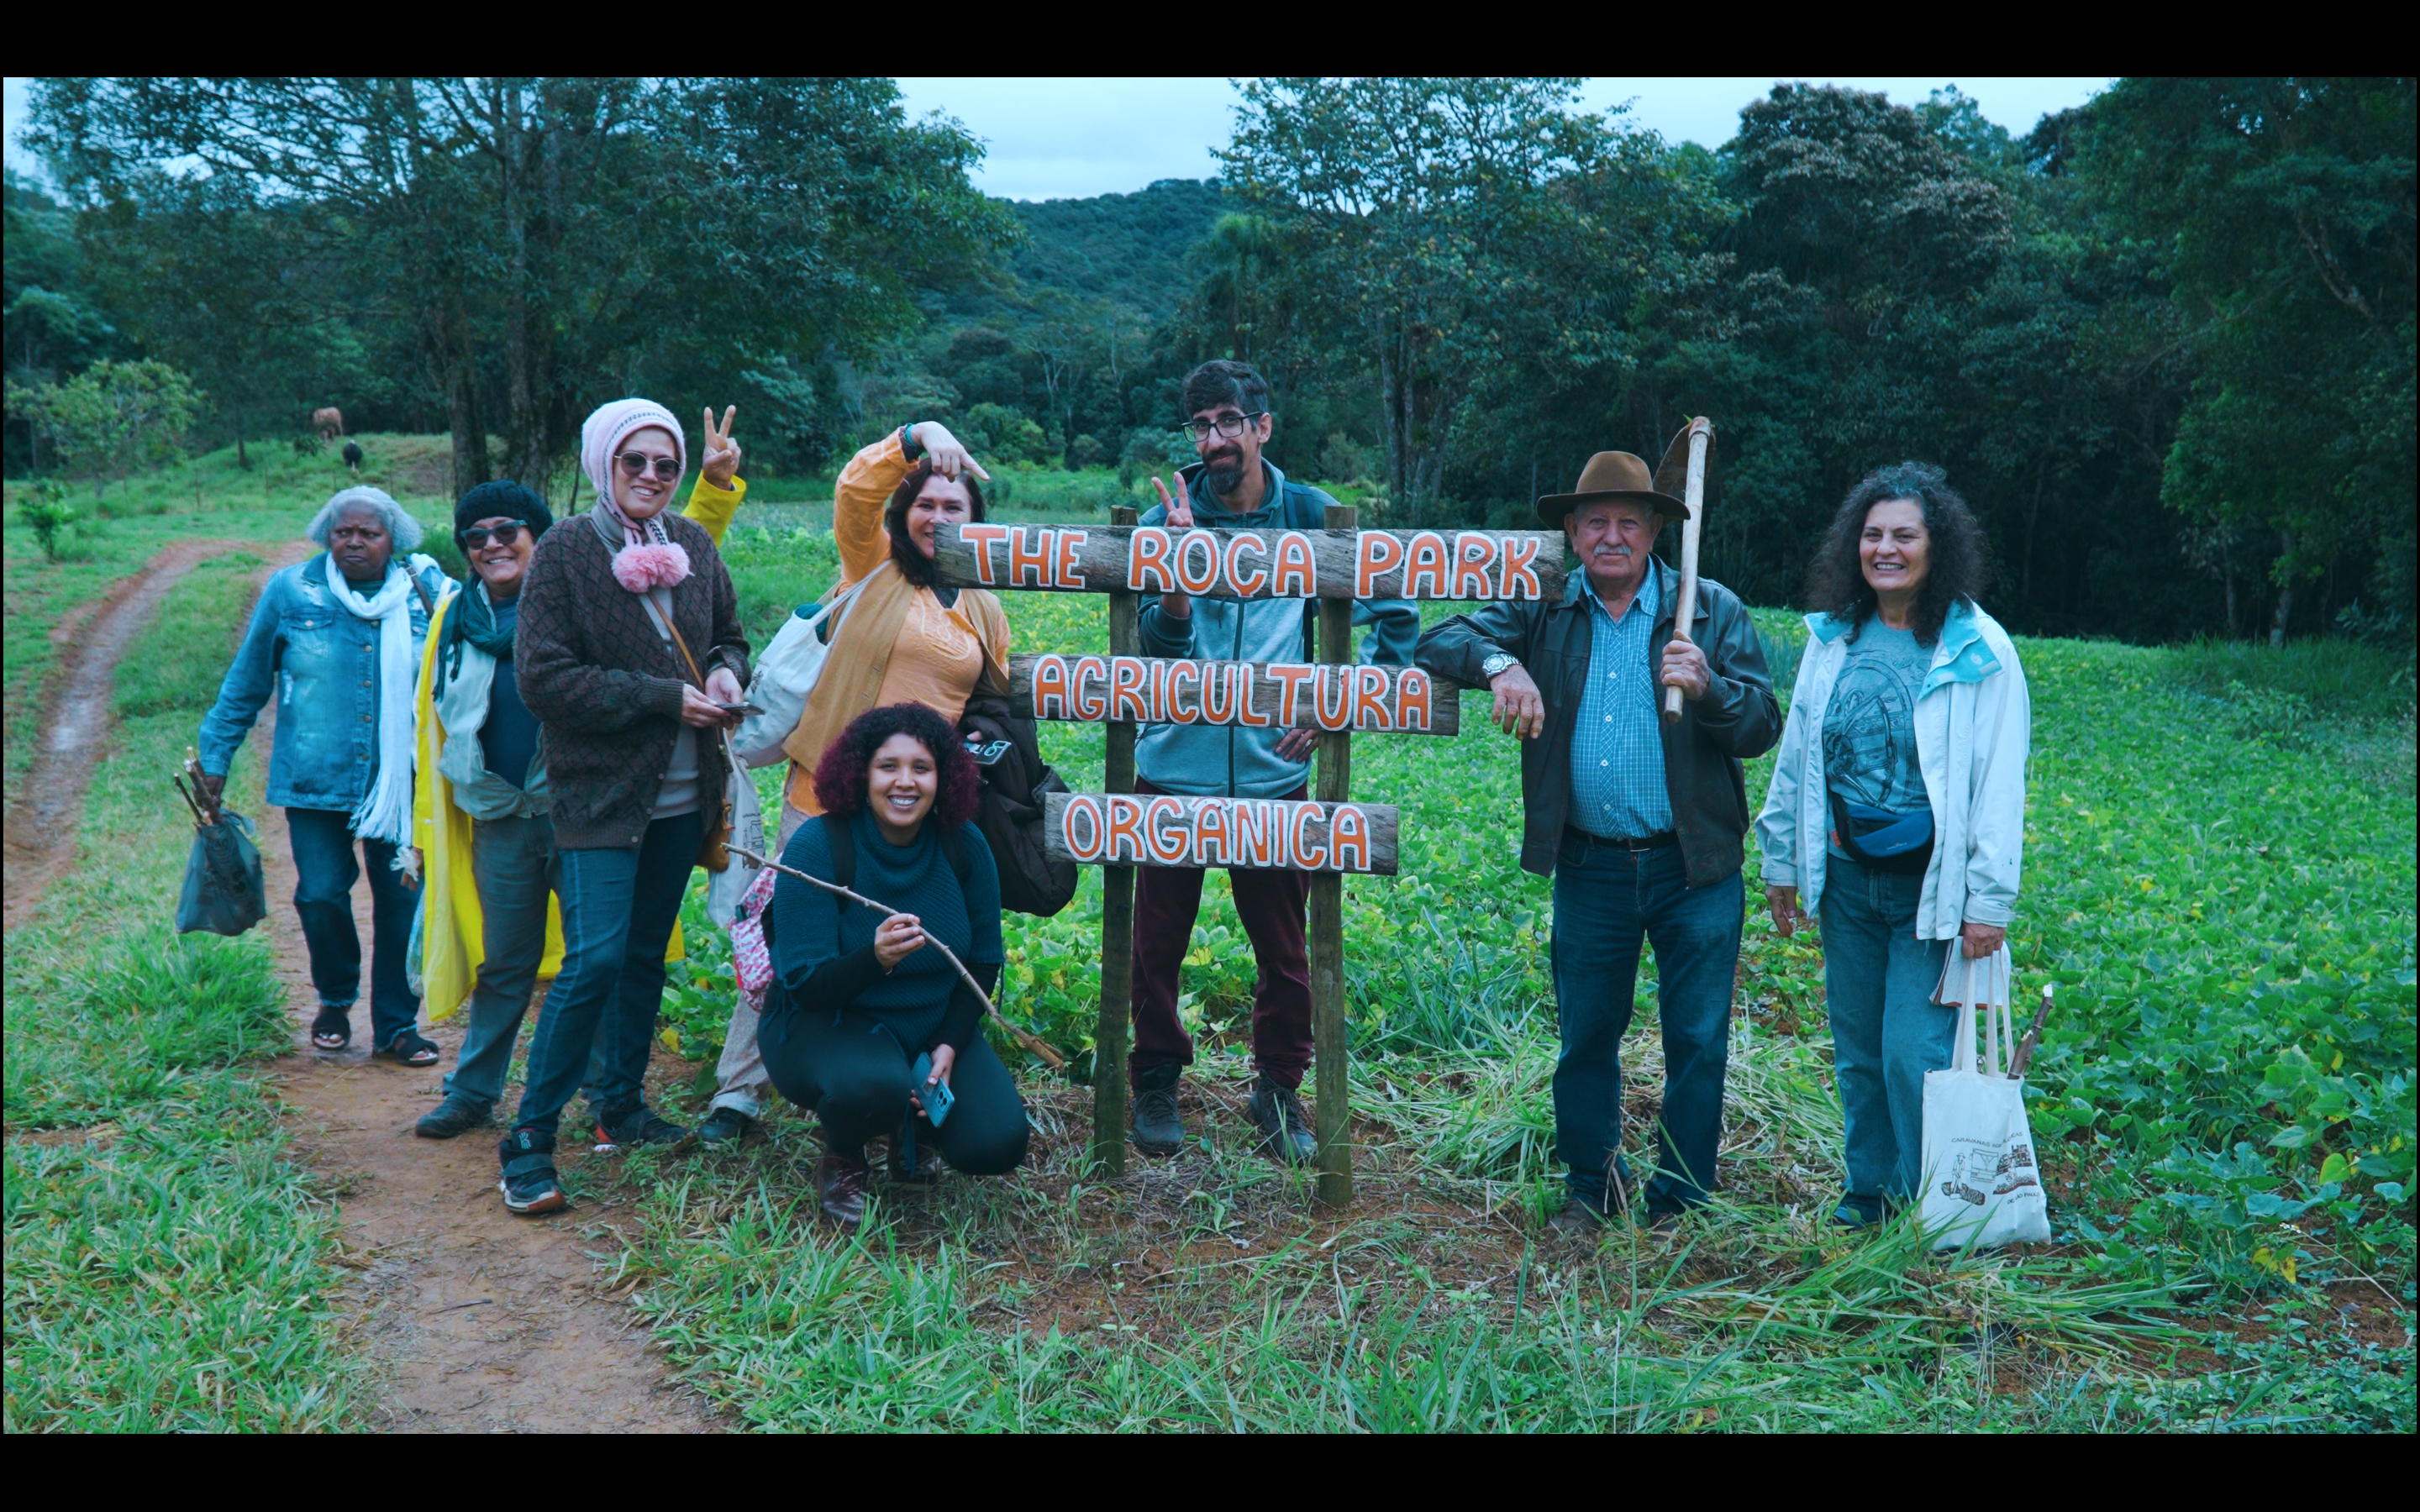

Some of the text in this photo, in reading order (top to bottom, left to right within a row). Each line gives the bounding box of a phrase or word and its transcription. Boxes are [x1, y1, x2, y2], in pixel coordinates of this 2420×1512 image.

[959, 524, 1541, 601] THE ROÇA PARK
[1032, 654, 1433, 732] AGRICULTURA
[1061, 794, 1371, 872] ORGÂNICA
[1951, 1137, 1991, 1147] CARAVANAS
